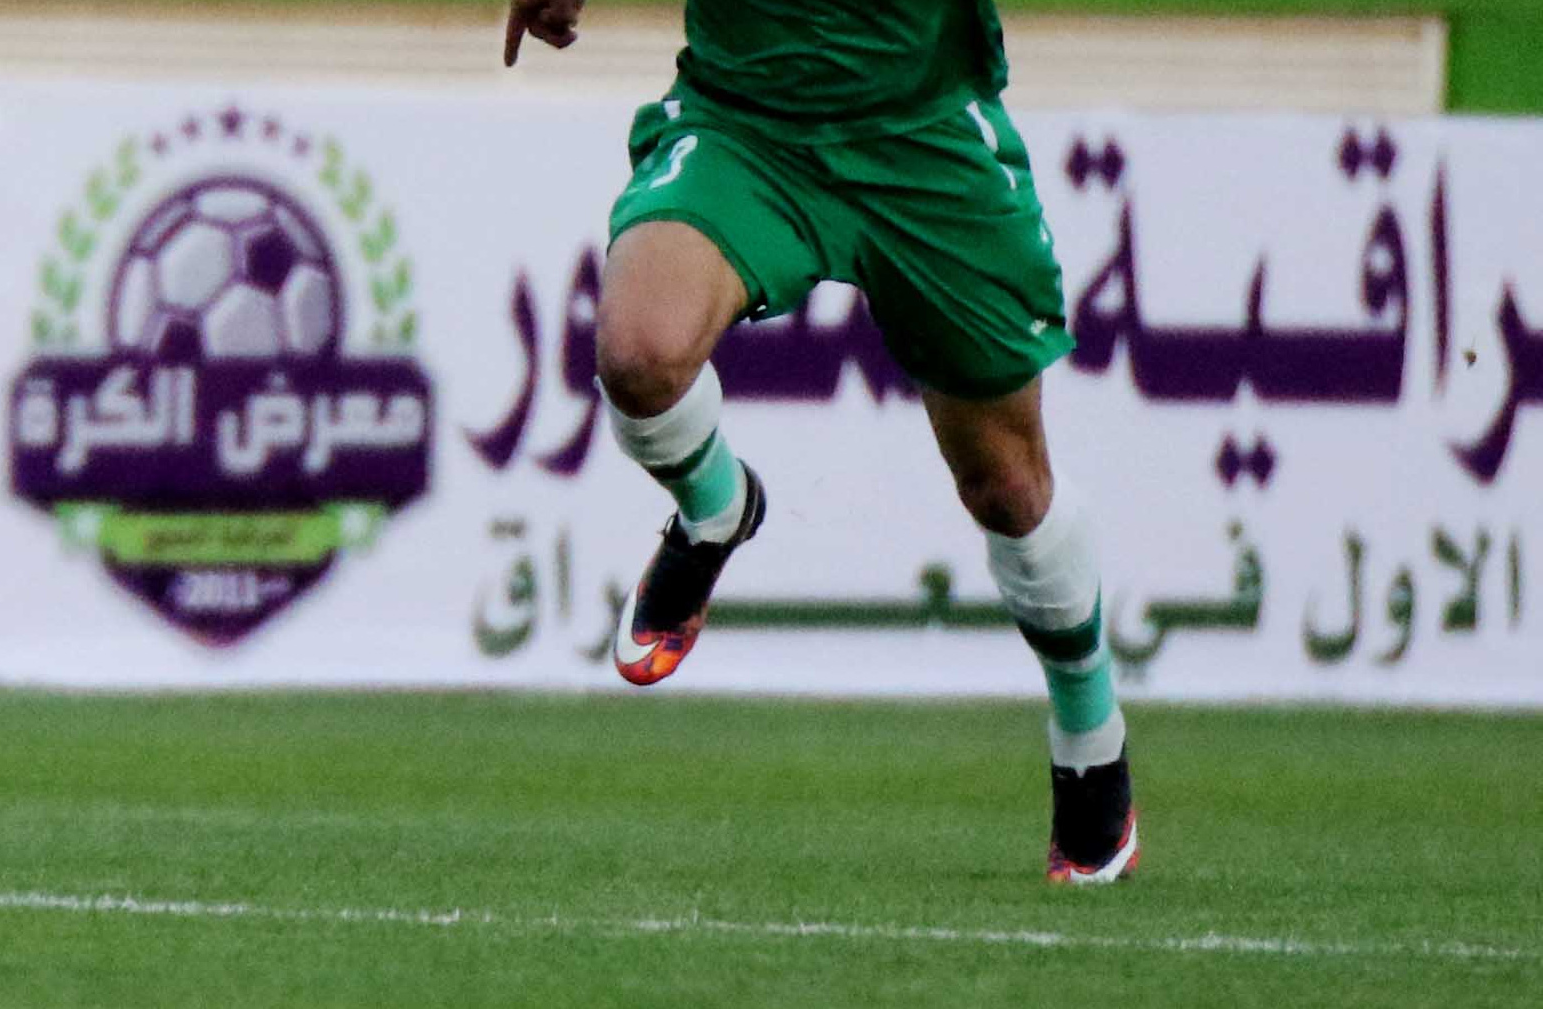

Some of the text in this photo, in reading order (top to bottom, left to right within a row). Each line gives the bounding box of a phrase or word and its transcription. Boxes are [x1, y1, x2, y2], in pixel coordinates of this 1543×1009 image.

[18, 366, 425, 475] معرض الكرة
[1108, 518, 1263, 684] في
